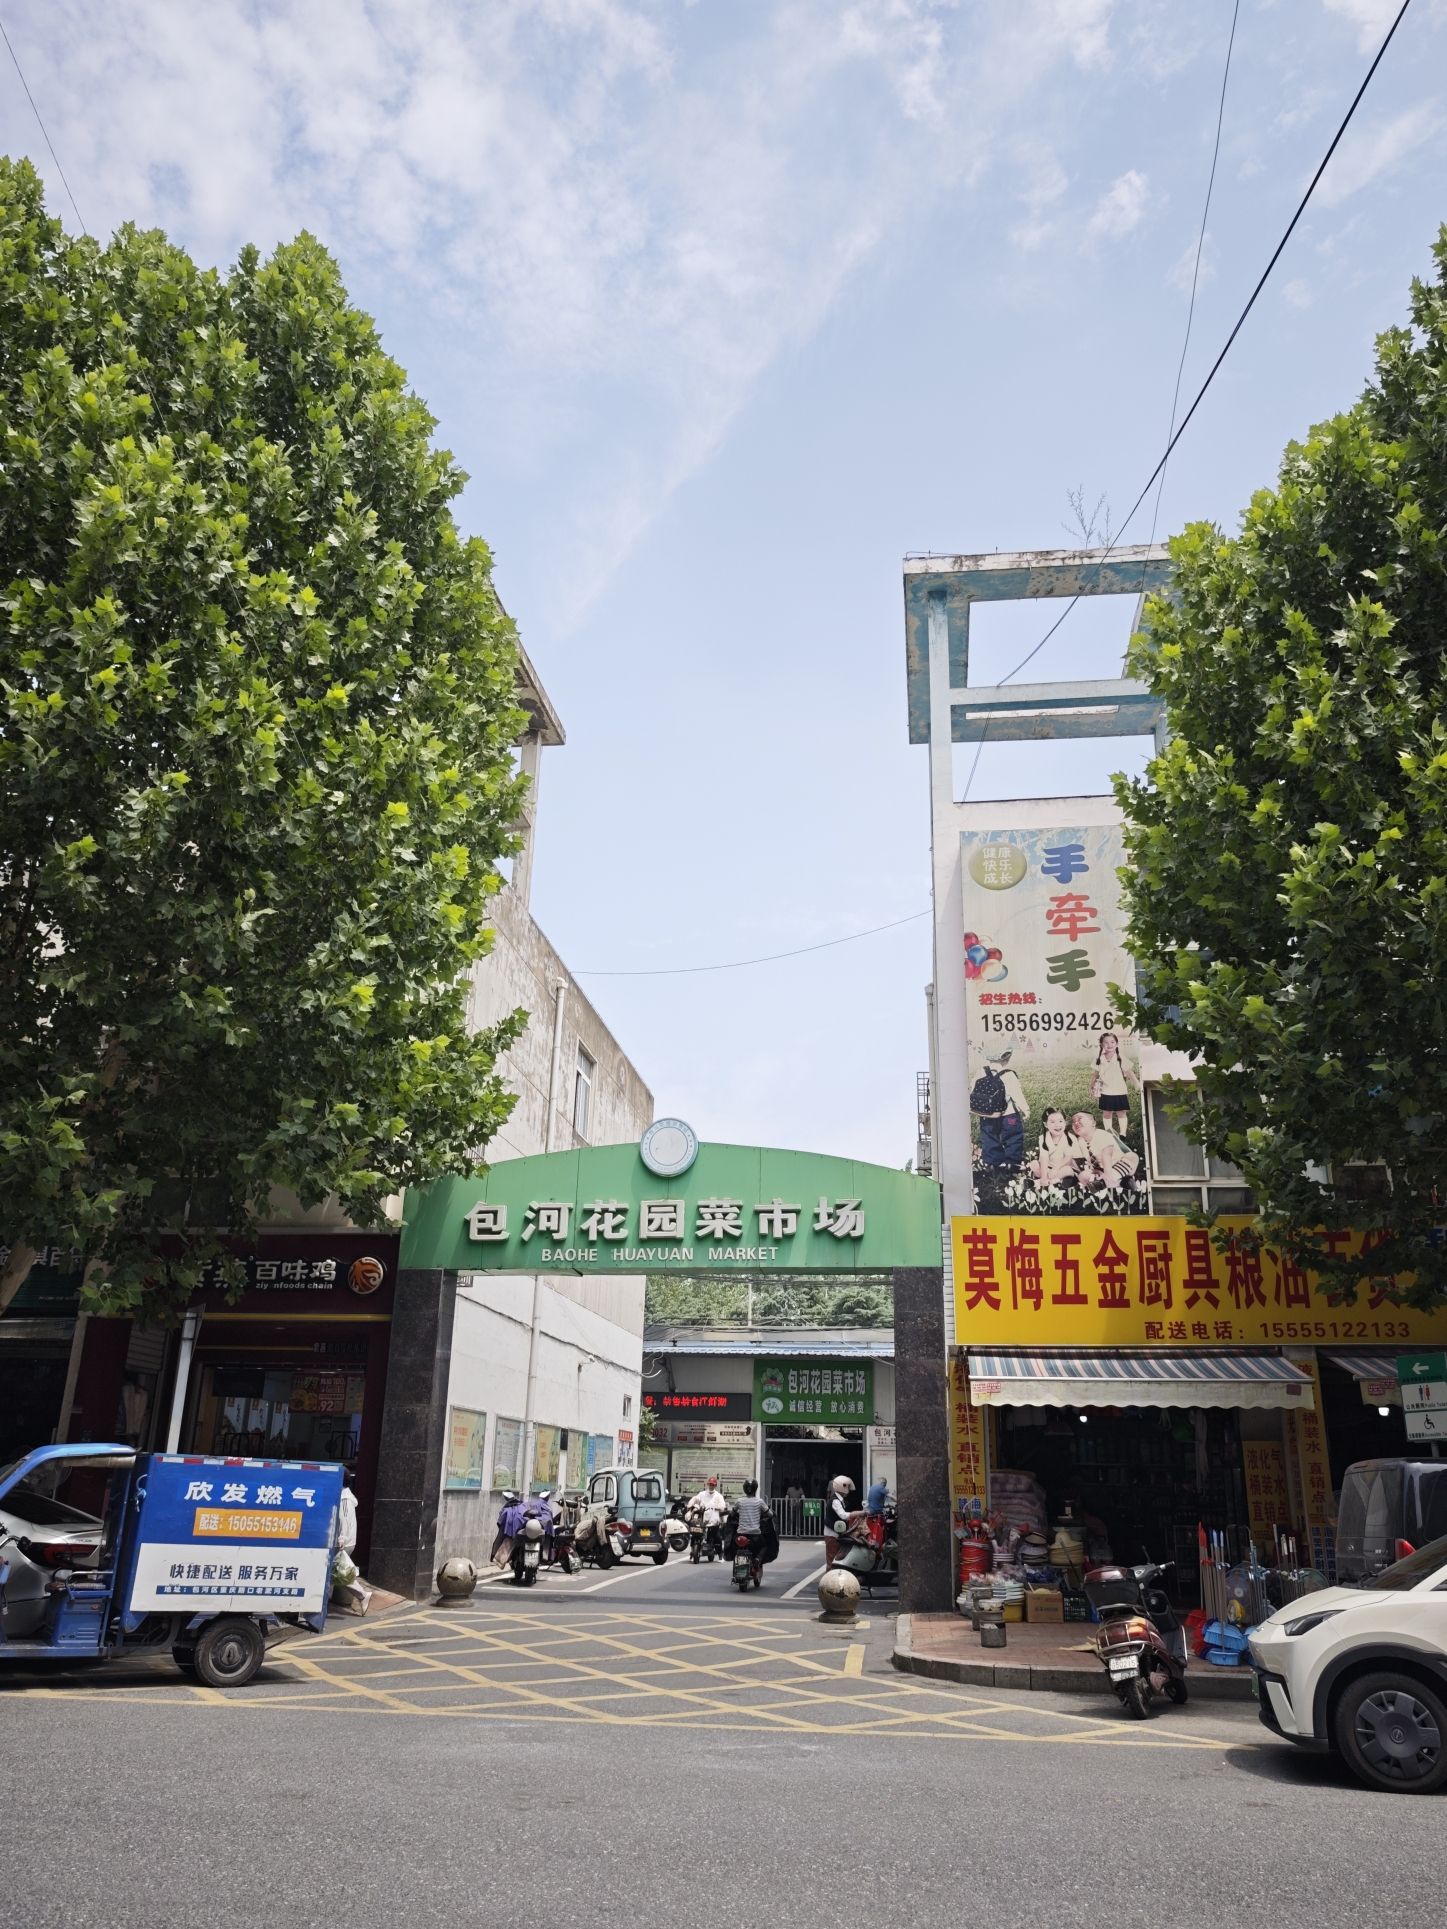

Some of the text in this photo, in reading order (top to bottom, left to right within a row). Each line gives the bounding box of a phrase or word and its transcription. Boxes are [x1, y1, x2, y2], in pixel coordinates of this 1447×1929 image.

[983, 847, 1012, 859] 健康
[983, 859, 1012, 872] 快乐
[983, 872, 1013, 884] 成长
[981, 1012, 1114, 1032] 15856992426
[464, 1197, 866, 1243] 包河花园菜市场
[541, 1246, 778, 1262] BAOHE HUAYUAN MARKET
[255, 1282, 305, 1290] ziynfoods
[788, 1368, 866, 1395] 包河花园菜市场
[789, 1399, 822, 1413] 诚信经营
[830, 1400, 864, 1414] 放心消费
[183, 1481, 316, 1508] 欣发燃气
[169, 1564, 299, 1581] 快捷配送 服务万家
